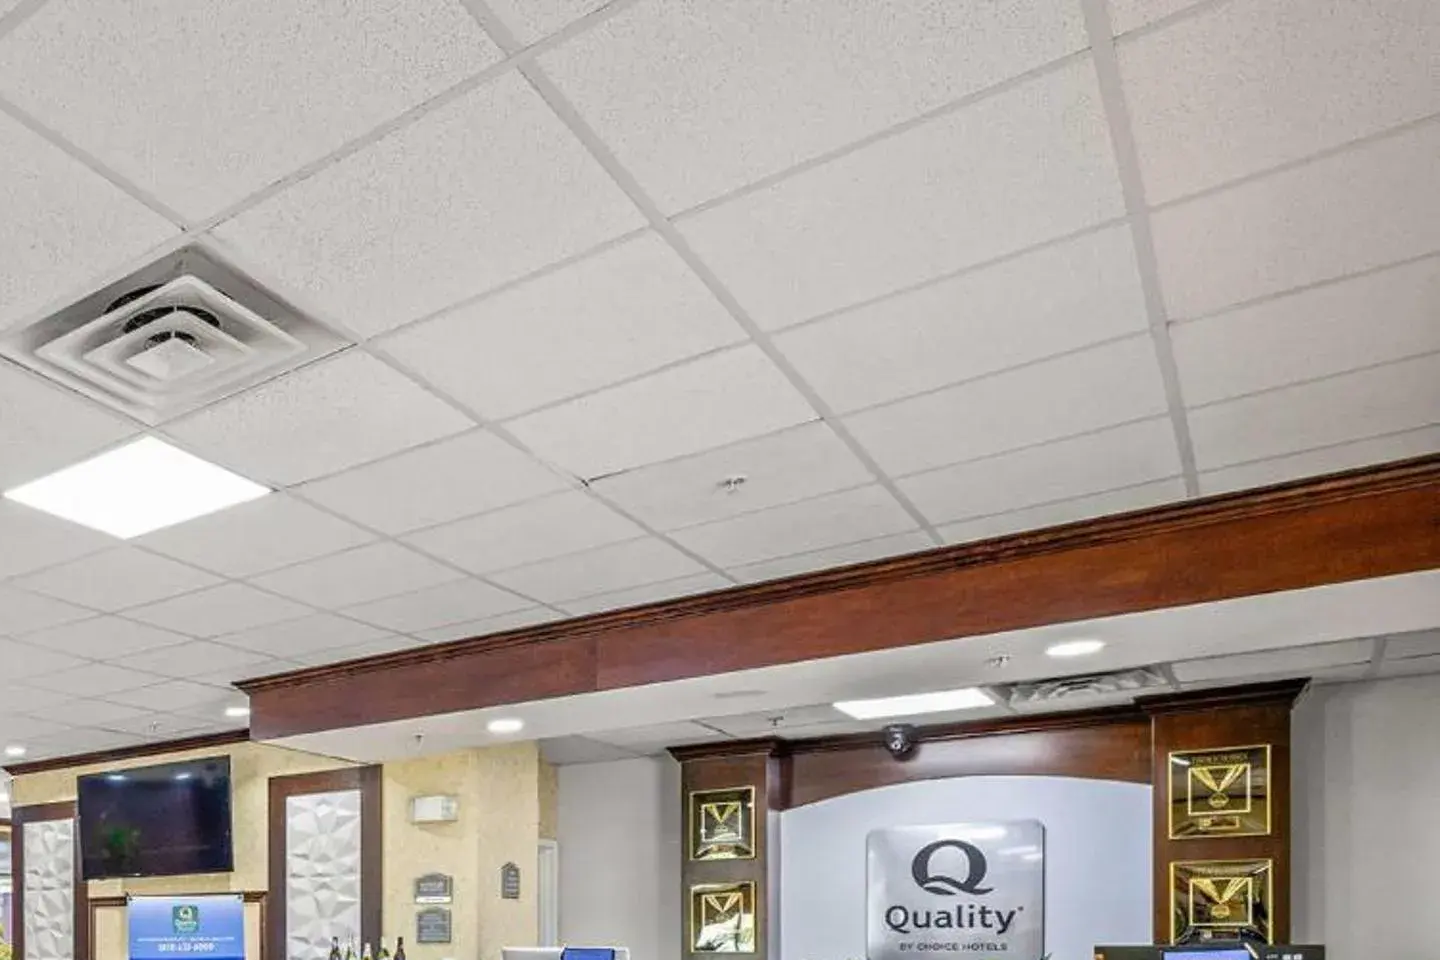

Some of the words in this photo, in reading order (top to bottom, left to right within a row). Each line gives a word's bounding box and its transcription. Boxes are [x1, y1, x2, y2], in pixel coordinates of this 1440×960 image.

[885, 904, 1017, 935] Quality
[899, 942, 913, 951] BY
[916, 942, 959, 951] CHOICE
[962, 942, 1008, 951] HOTELS
